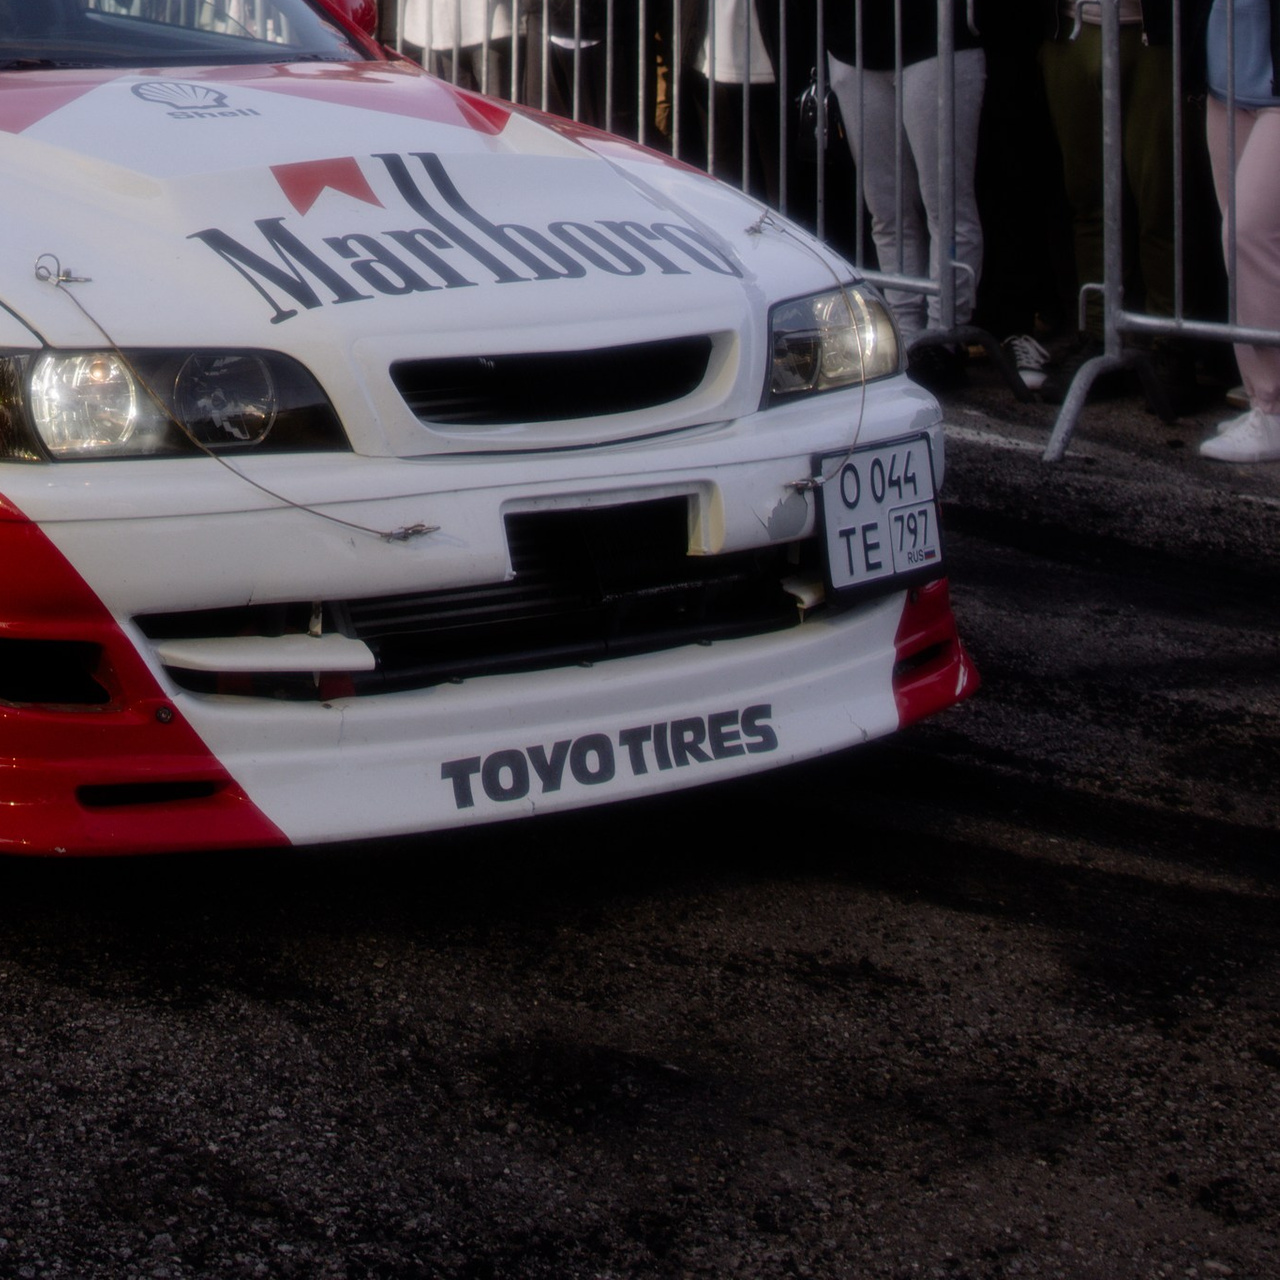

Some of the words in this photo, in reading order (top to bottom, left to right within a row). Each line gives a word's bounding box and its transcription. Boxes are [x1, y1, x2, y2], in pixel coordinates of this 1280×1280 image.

[166, 108, 261, 119] Shell
[186, 152, 745, 325] Marlboro
[870, 450, 918, 503] 044
[894, 509, 928, 552] 797
[907, 550, 924, 564] RUS
